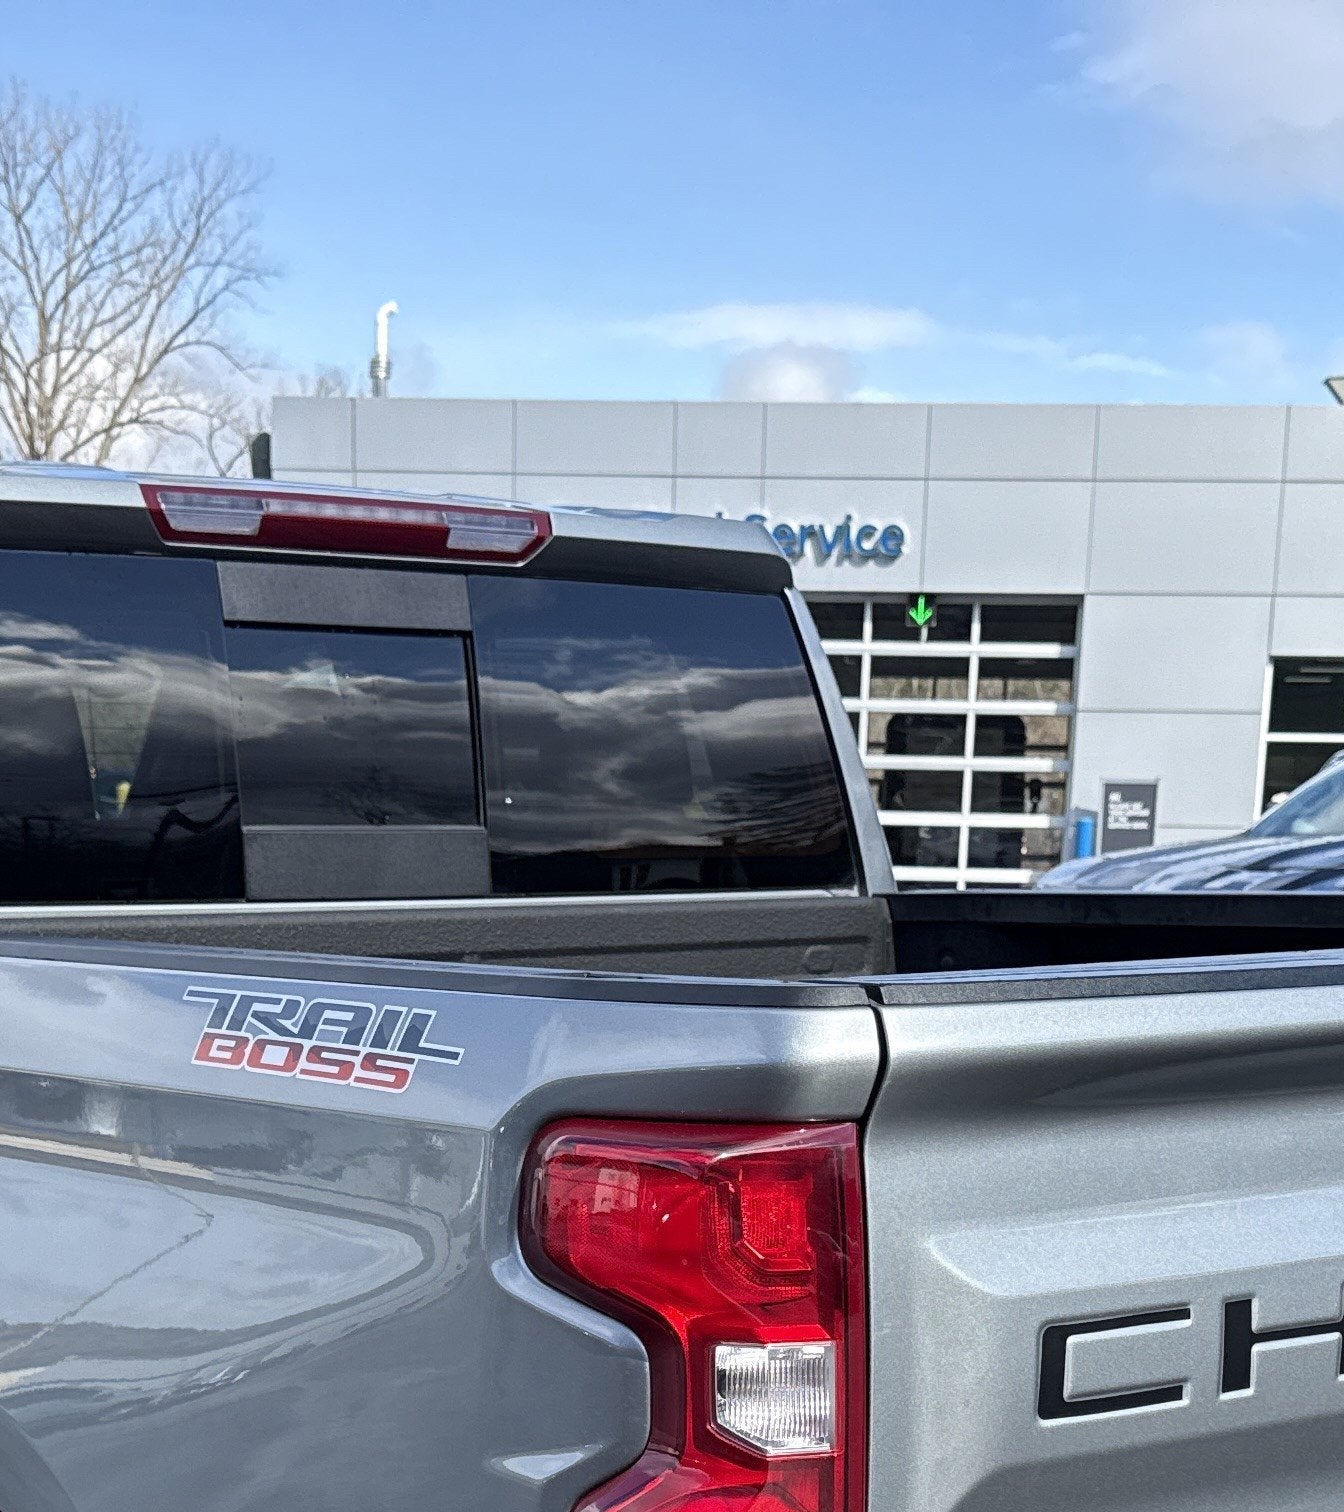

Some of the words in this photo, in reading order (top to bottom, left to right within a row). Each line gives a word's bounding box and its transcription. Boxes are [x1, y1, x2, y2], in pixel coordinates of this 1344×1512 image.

[746, 513, 905, 560] ervice
[183, 985, 465, 1065] TRAIL
[191, 1028, 418, 1093] BOSS
